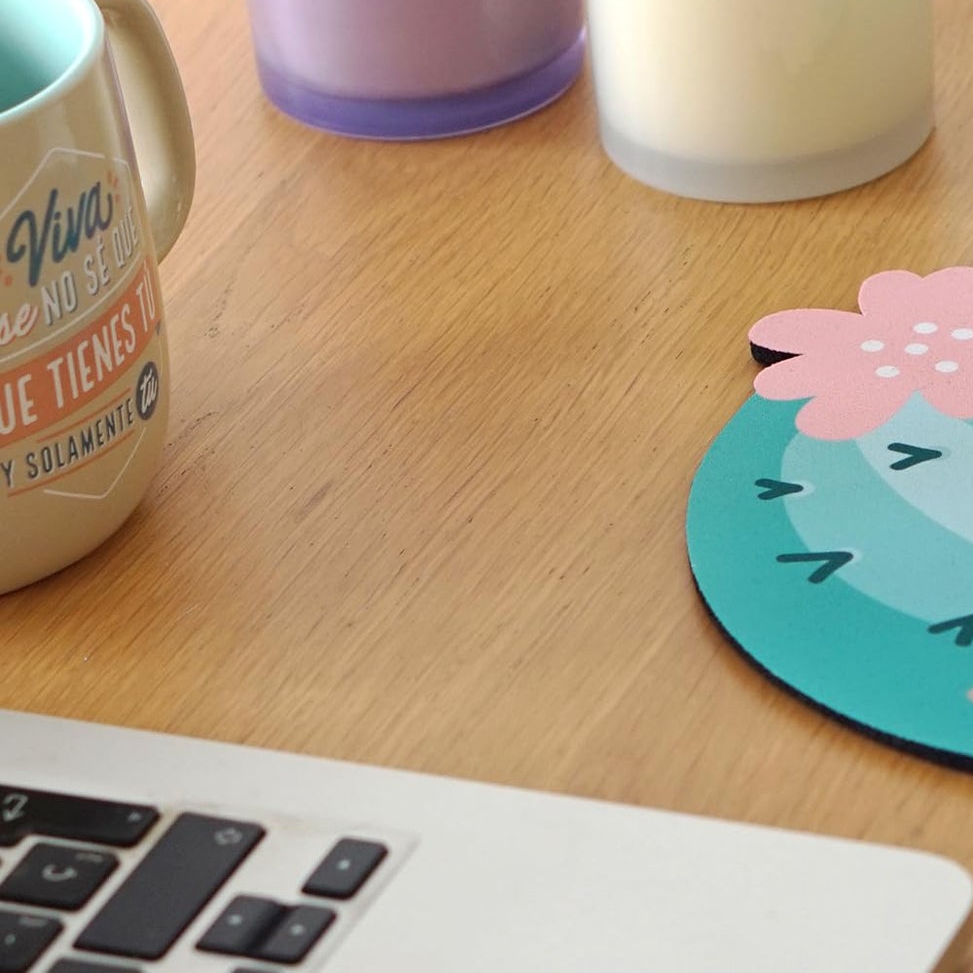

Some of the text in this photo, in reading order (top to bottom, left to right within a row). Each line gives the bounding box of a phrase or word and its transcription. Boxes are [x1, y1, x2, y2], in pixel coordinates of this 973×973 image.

[6, 181, 114, 288] Viva
[40, 270, 79, 327] NO
[46, 303, 137, 409] TIENES
[0, 458, 16, 489] Y
[25, 397, 135, 479] SOLAMENTE
